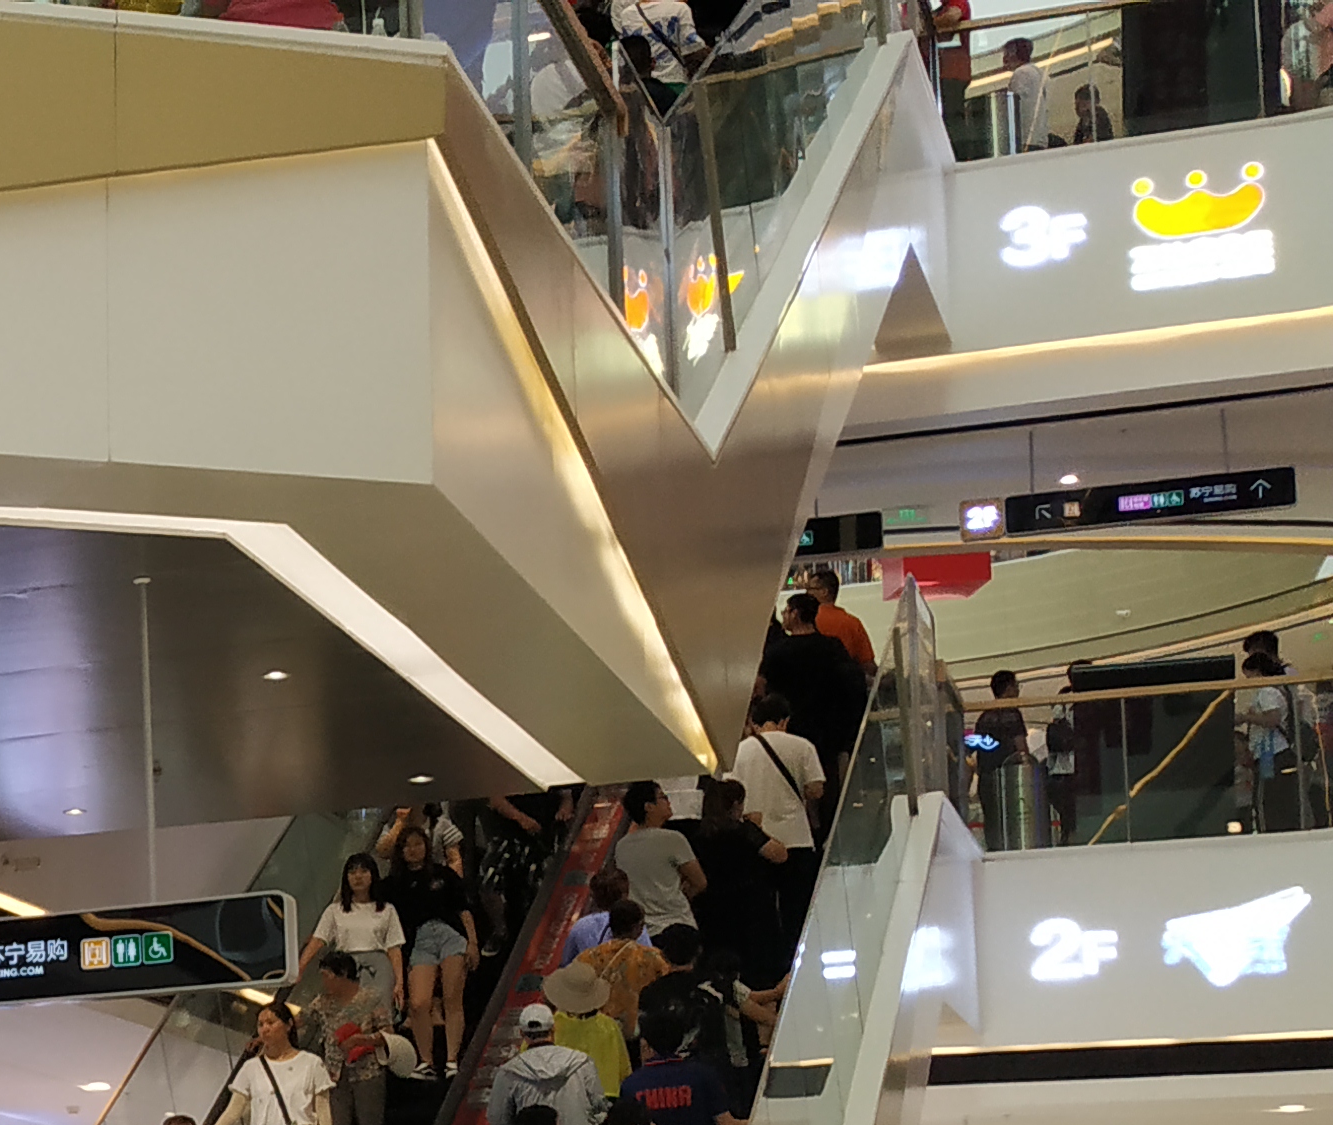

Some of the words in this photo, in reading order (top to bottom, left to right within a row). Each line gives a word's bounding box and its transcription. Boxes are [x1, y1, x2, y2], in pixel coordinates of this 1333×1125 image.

[1000, 205, 1088, 267] 3F
[966, 505, 1000, 530] 2F
[1030, 917, 1118, 981] 2F
